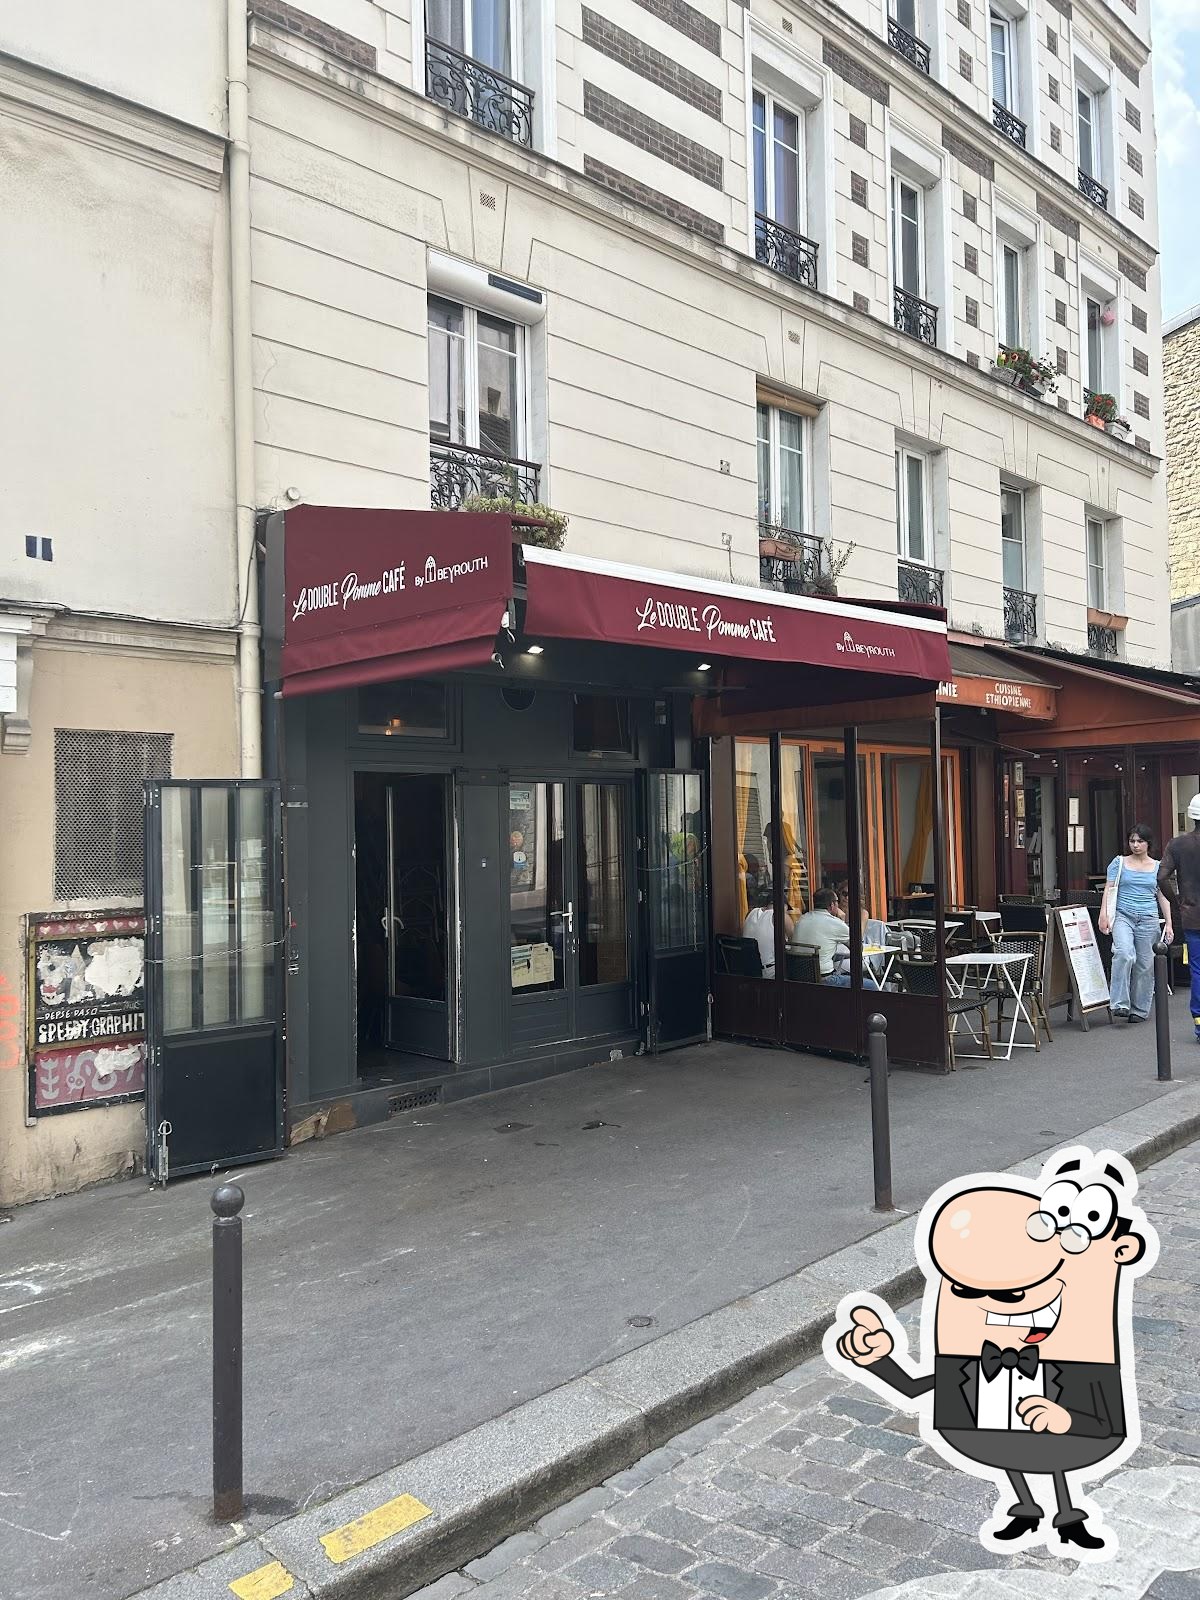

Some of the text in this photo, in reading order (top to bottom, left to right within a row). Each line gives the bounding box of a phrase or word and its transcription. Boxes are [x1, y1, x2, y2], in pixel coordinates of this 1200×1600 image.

[415, 556, 489, 587] By BEYROUTH
[292, 560, 406, 622] Le DOUBLE Pomme CAFÉ
[635, 597, 777, 643] Le DOUBLE Pomme CAFÉ
[836, 643, 896, 659] By BEYROUTH
[985, 693, 1031, 708] ETHIOPIENNE
[994, 682, 1022, 696] CUISINE
